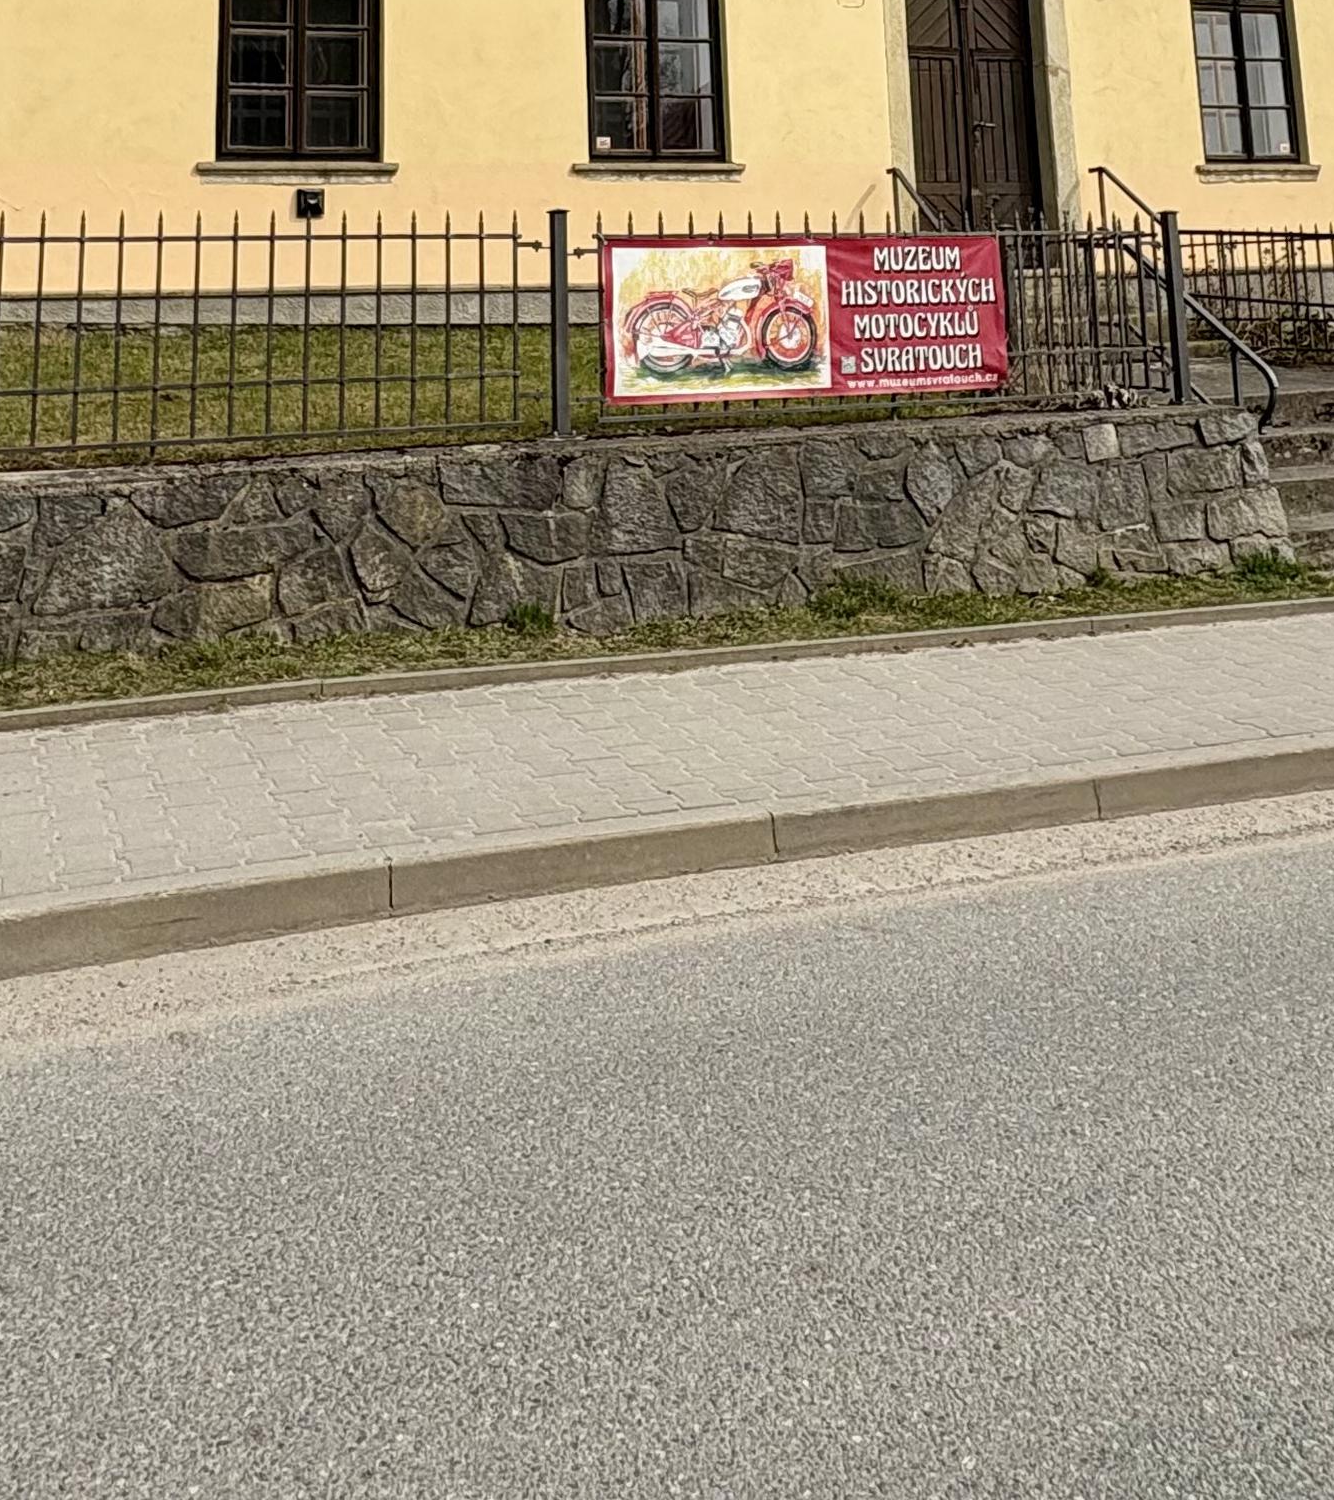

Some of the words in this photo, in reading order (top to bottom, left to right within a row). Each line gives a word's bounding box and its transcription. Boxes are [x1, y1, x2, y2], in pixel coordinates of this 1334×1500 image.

[873, 245, 961, 273] MUZEUM
[840, 272, 996, 306] HISTORICKÝCH
[853, 305, 979, 340] MOTOCYKLŮ
[860, 343, 983, 374] SVRATOUCH
[847, 372, 998, 389] www.muzeumsvratouch.cz
